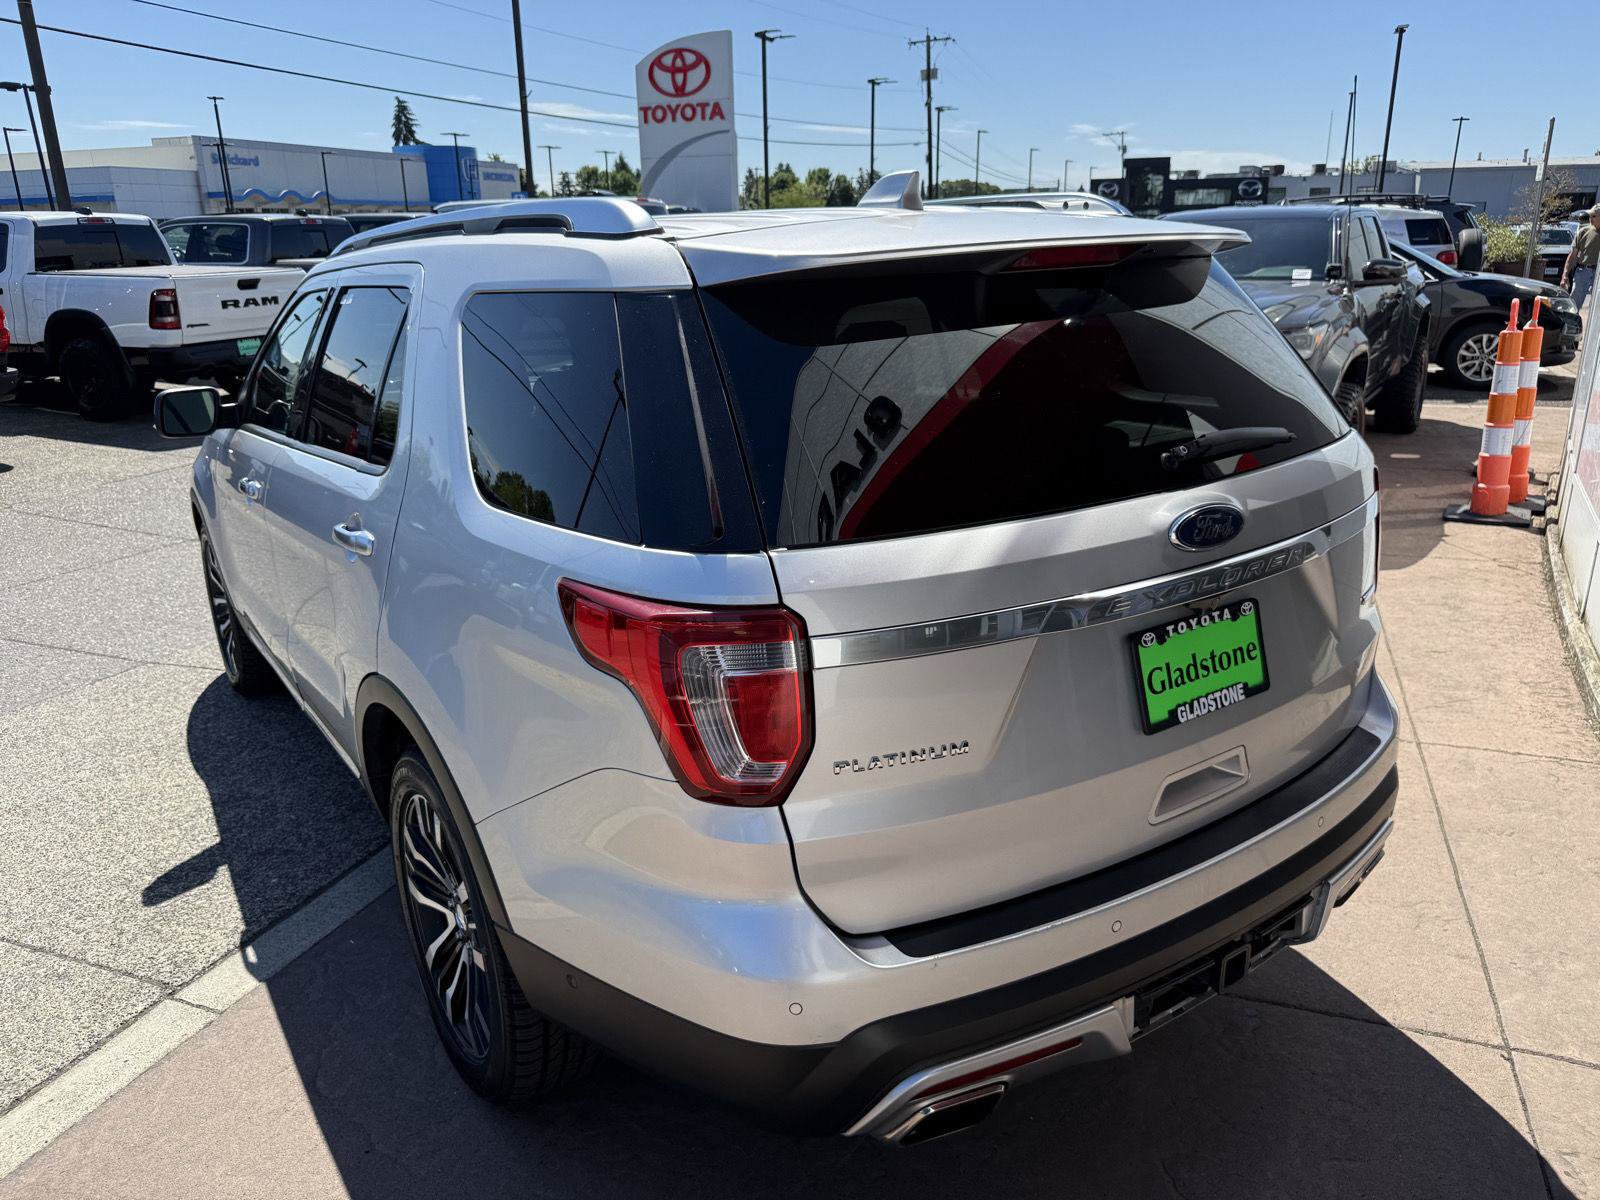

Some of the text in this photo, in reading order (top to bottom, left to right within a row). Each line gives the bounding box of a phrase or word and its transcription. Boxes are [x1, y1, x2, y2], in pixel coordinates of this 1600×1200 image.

[639, 101, 726, 125] TOYOTA
[220, 295, 279, 310] RAM
[1193, 514, 1235, 542] Ford
[1107, 547, 1305, 616] EXPLORER
[1166, 608, 1231, 637] TOYOTA
[1146, 641, 1258, 696] Gladstone
[1177, 682, 1246, 723] GLADSTONE
[832, 739, 970, 776] PLATINUM
